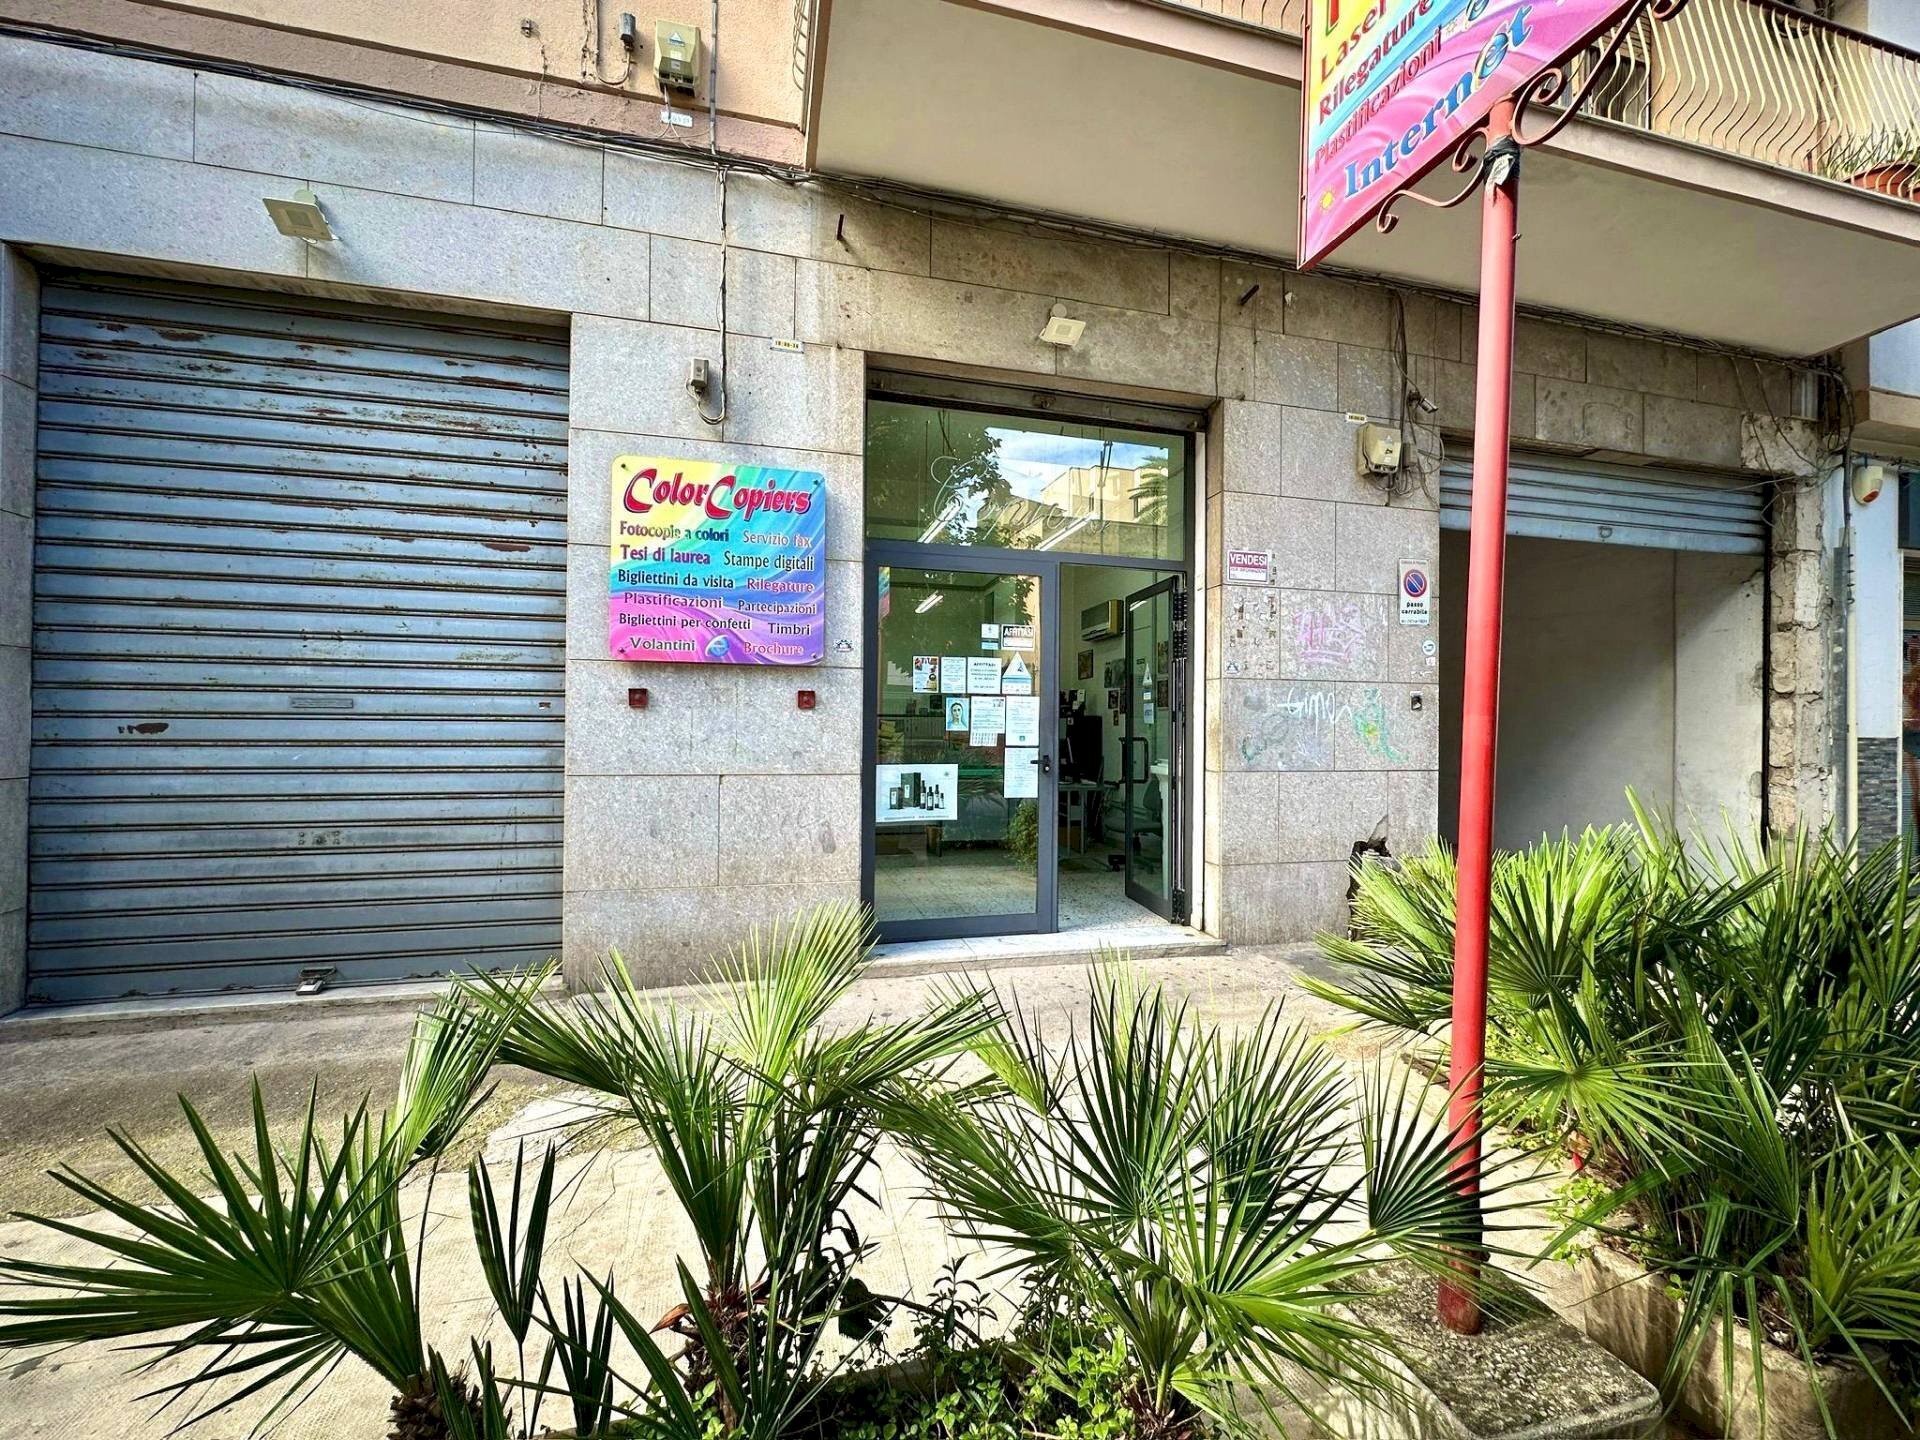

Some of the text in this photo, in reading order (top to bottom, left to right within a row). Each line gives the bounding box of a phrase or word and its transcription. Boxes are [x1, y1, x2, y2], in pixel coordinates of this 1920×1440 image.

[1318, 0, 1434, 126] Rilegature
[1314, 24, 1442, 175] Plastificazioni
[1344, 4, 1533, 198] Internet
[620, 521, 729, 542] Fotocopie a colori
[743, 530, 812, 548] Servizio fax
[620, 544, 711, 564] Tesi di laurea
[724, 550, 814, 572] Stampe digitali
[1230, 552, 1267, 566] VENDESI
[618, 569, 734, 589] Bigliettini da visita
[747, 578, 814, 593] Rilegature
[624, 592, 722, 608] Plastificazioni
[738, 599, 816, 614] Partecipazioni
[619, 613, 751, 630] Bigliettini per confetti
[768, 622, 810, 635] Timbri
[630, 637, 695, 651] Volantini
[744, 642, 804, 656] Brochure
